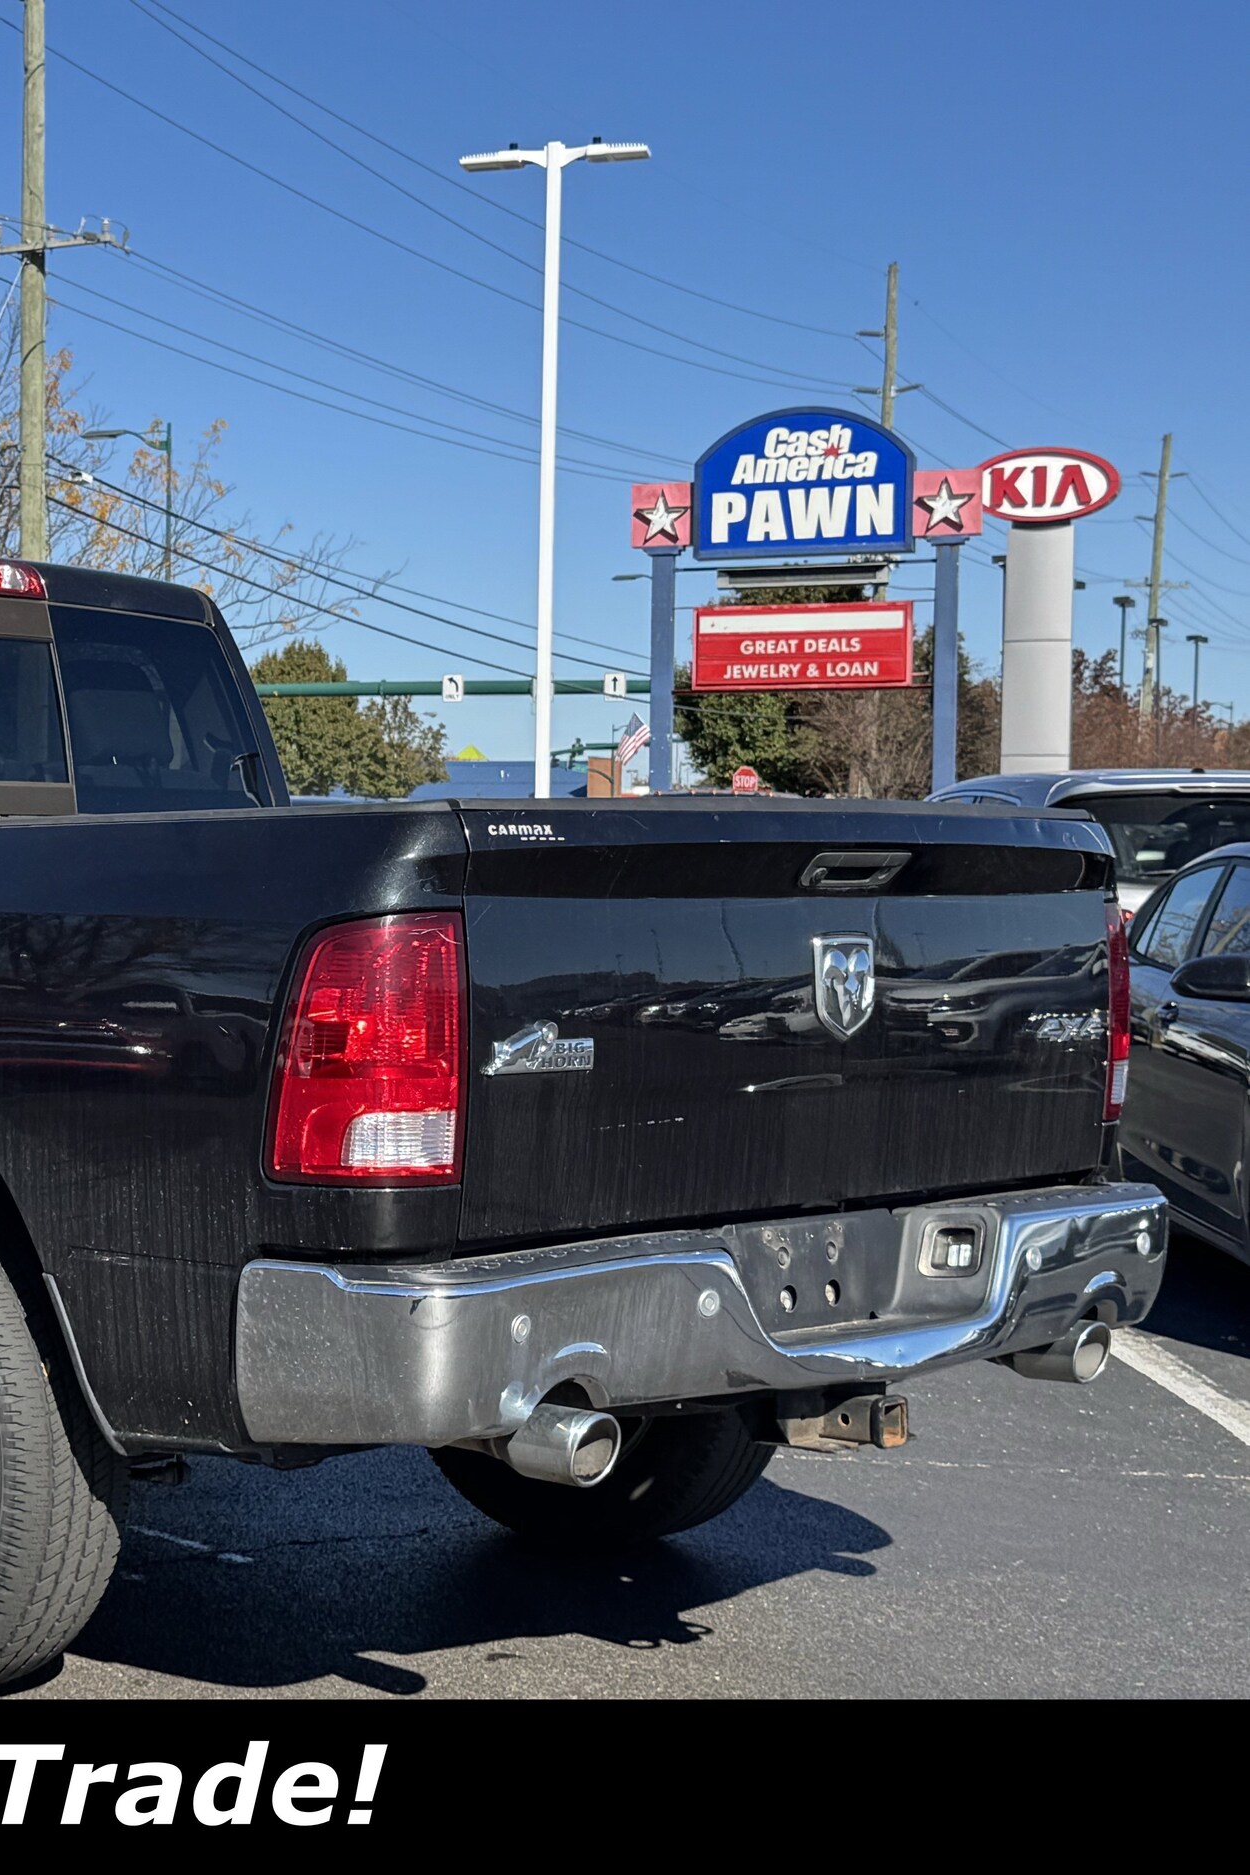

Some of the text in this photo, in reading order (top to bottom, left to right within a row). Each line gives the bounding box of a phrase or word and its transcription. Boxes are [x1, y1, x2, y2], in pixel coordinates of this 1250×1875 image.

[764, 424, 852, 459] Cash
[731, 451, 878, 485] America
[989, 464, 1092, 508] KIA
[711, 483, 894, 543] PAWN
[740, 637, 861, 655] GREAT DEALS
[723, 661, 879, 680] JEWELRY & LOAN
[735, 775, 756, 787] STOP
[555, 1042, 585, 1054] BIG
[541, 1055, 591, 1068] HORN
